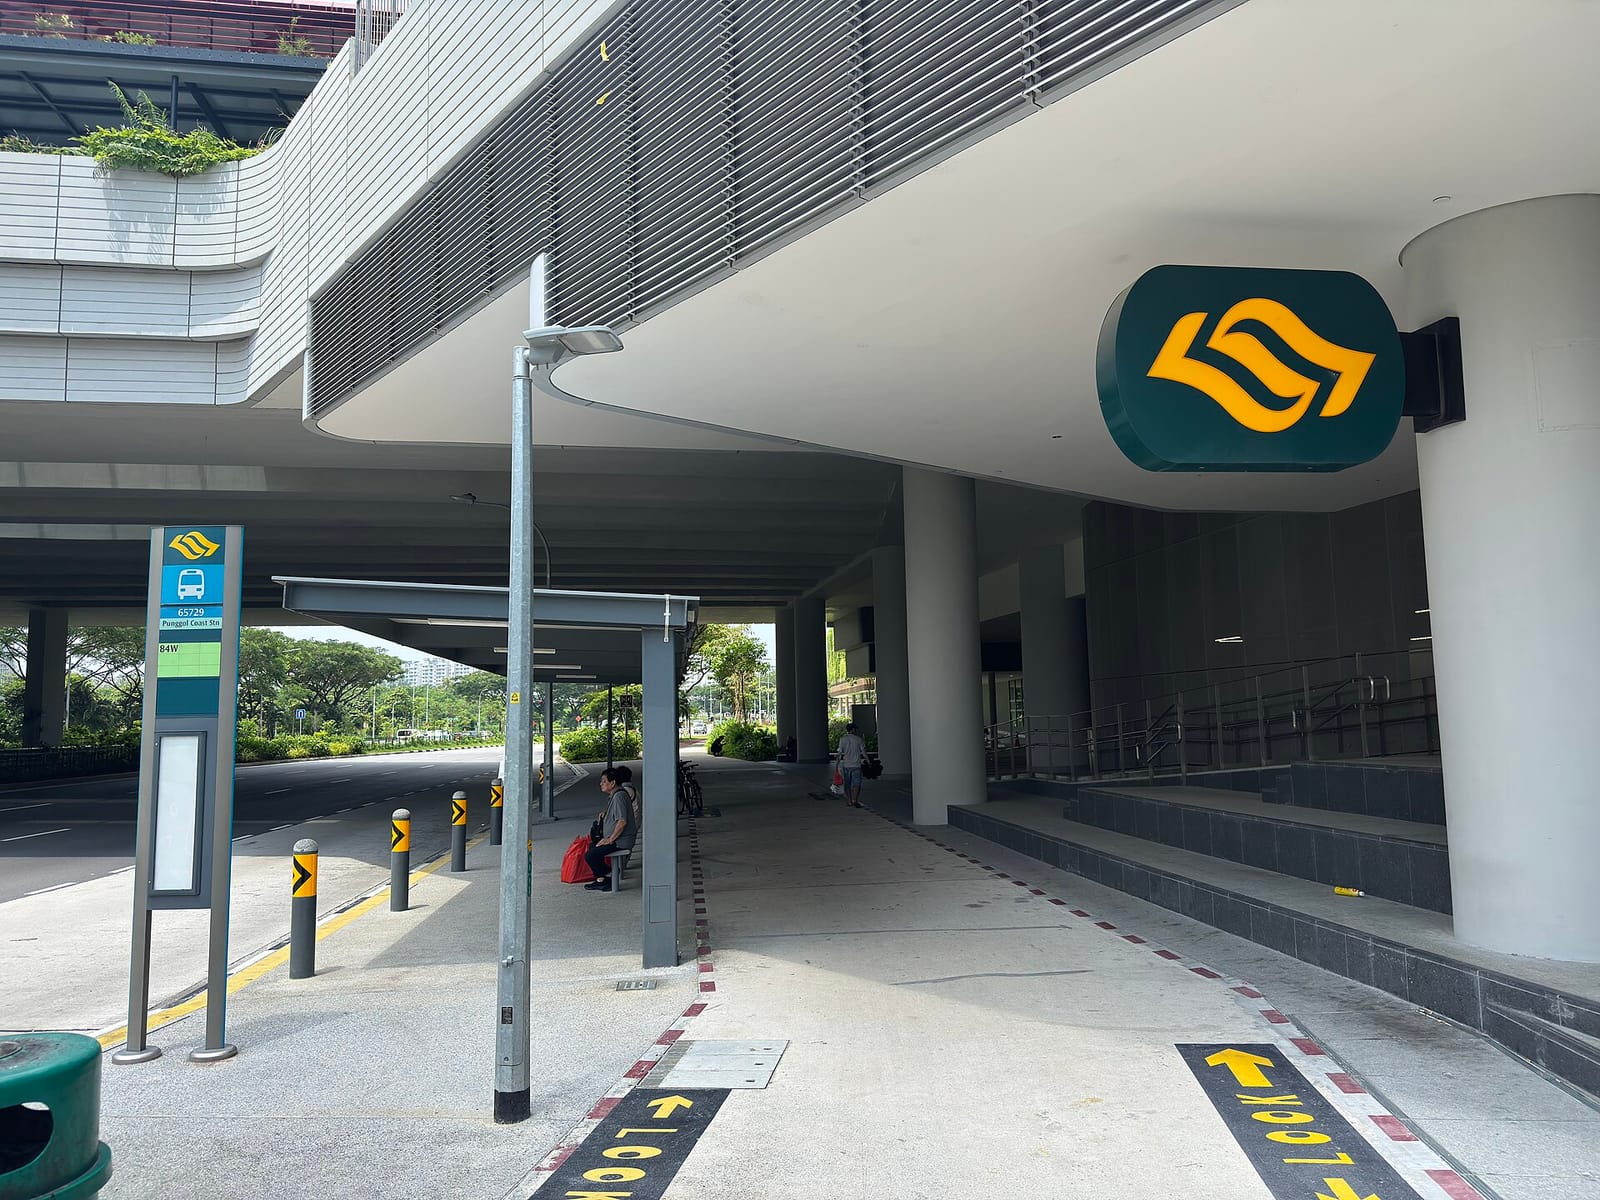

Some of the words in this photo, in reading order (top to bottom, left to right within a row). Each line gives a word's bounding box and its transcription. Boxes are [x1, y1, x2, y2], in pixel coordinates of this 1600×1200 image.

[177, 608, 205, 617] 65729
[162, 620, 189, 628] Punggol
[190, 619, 208, 627] Coast
[209, 619, 220, 627] Stn
[159, 644, 179, 653] 84W
[1235, 1093, 1355, 1165] LOOK
